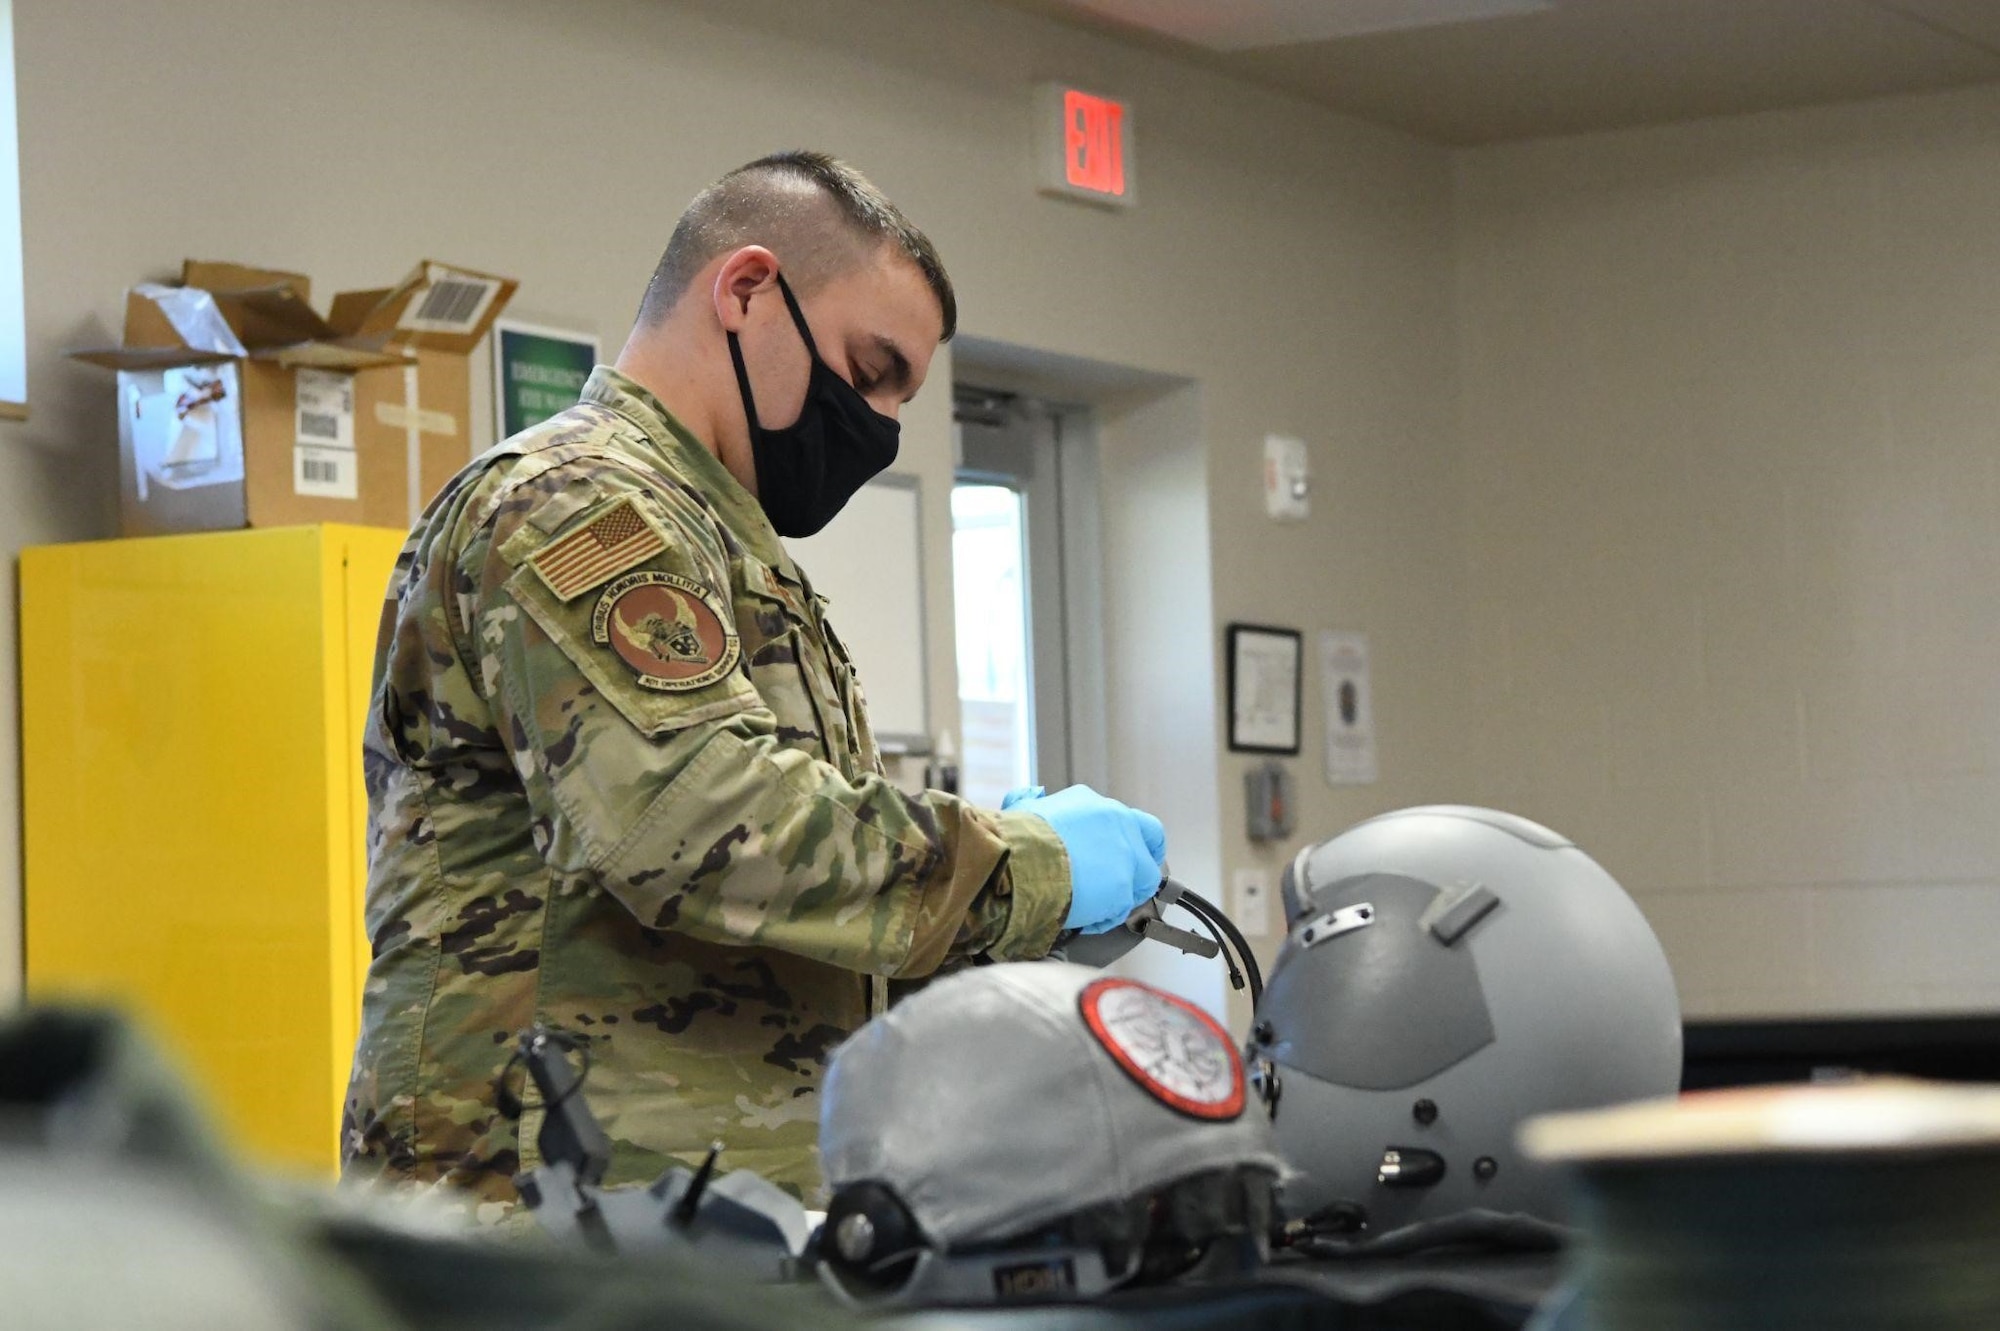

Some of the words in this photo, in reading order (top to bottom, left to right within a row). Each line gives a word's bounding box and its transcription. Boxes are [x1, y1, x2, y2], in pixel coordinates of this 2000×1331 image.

[1064, 90, 1125, 196] EXIT
[595, 600, 611, 641] VIRIBUS
[606, 573, 649, 599] HONORIS
[652, 573, 701, 595] MOLLITIA
